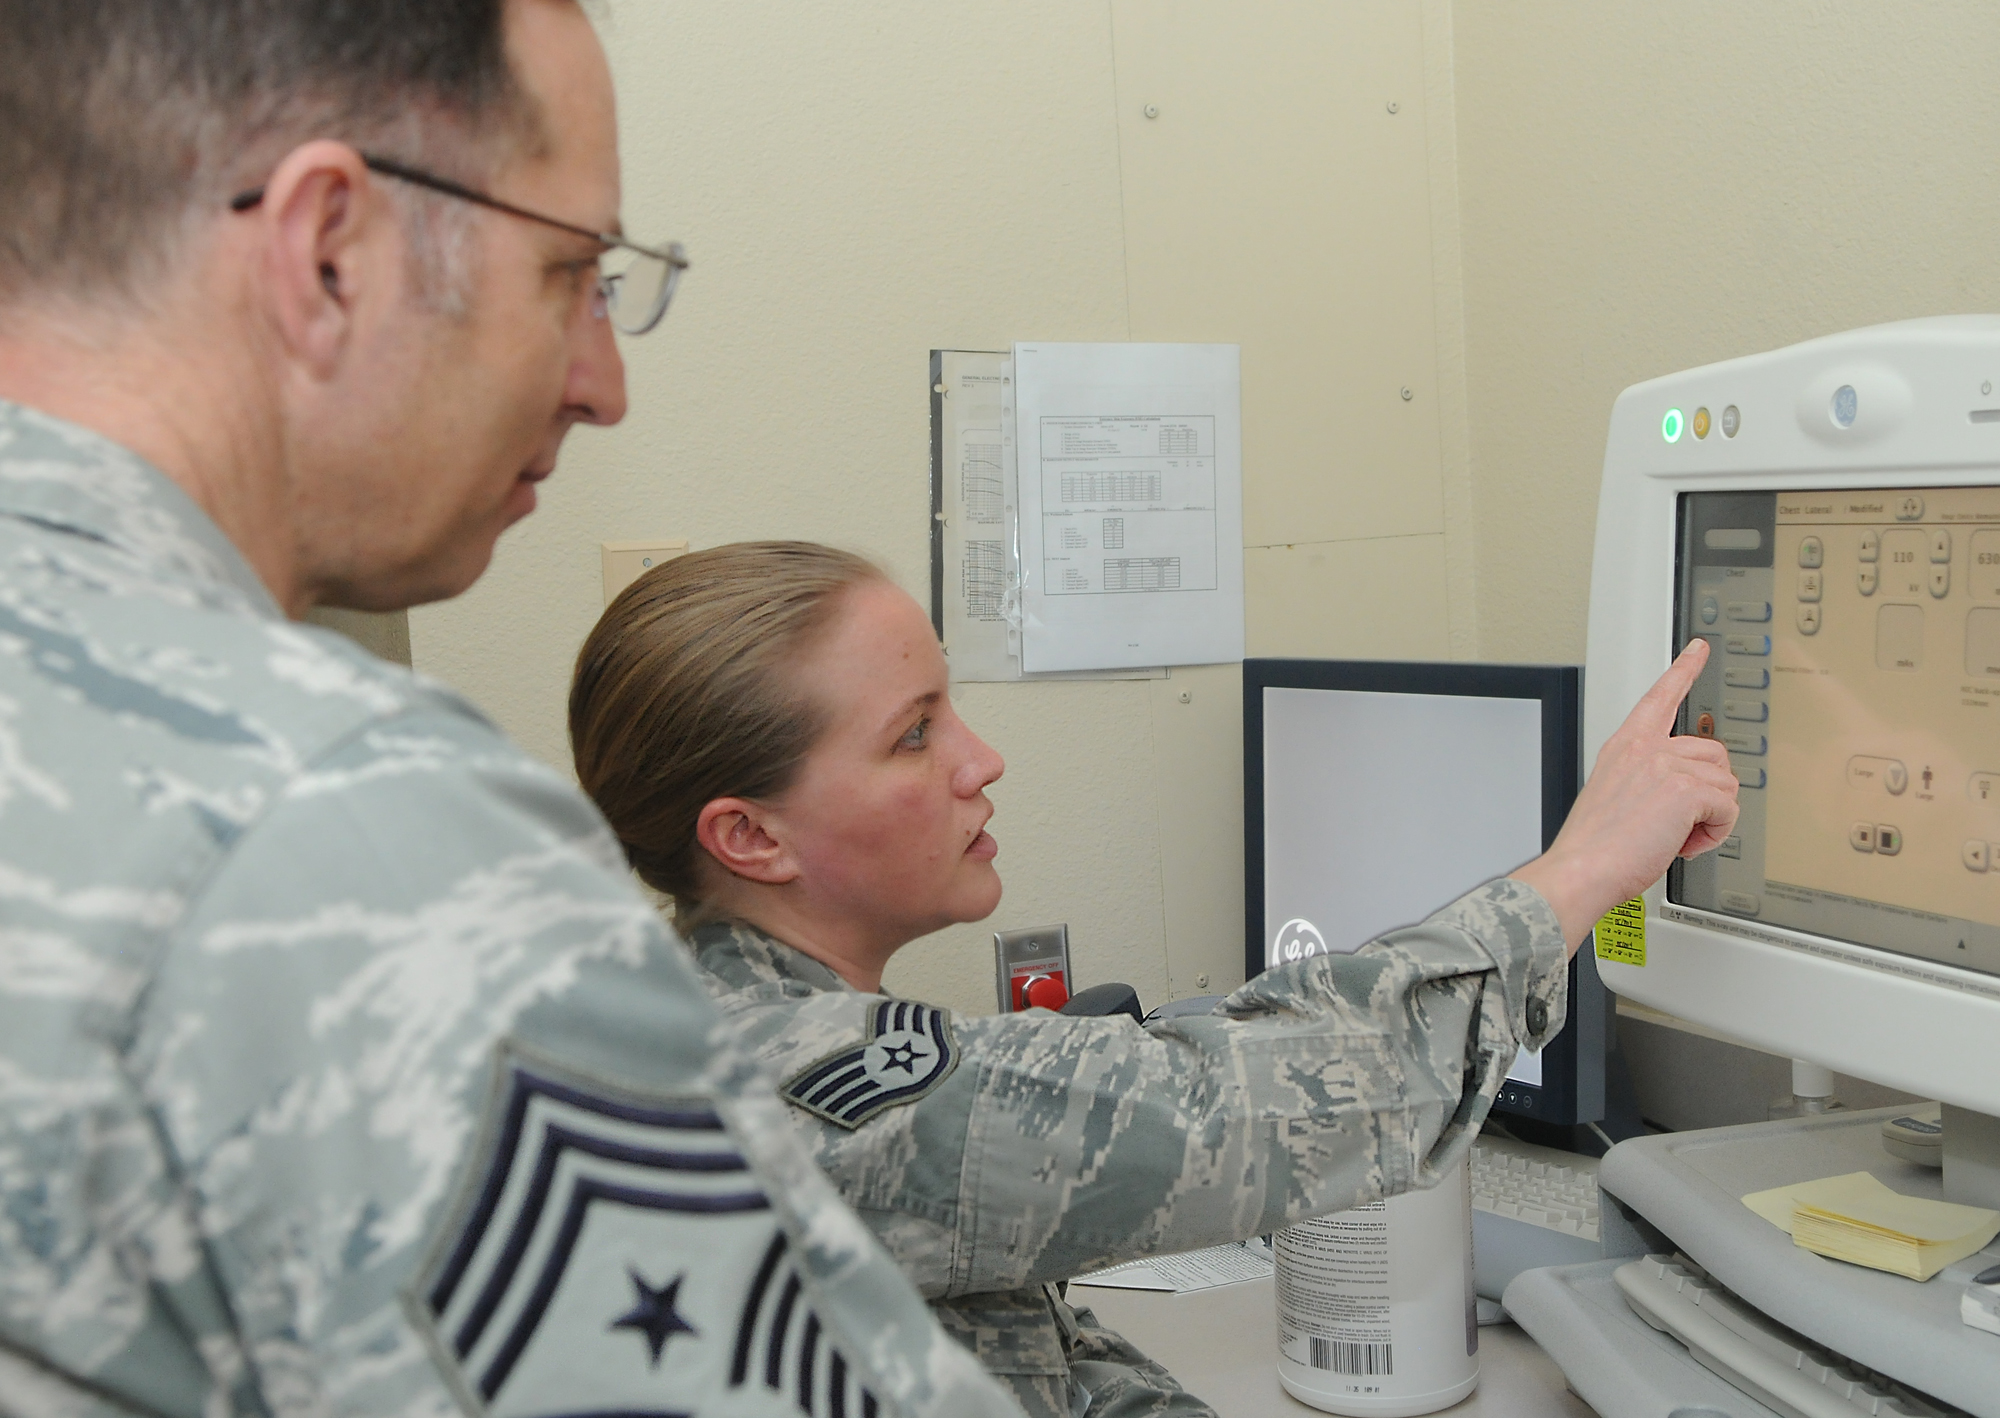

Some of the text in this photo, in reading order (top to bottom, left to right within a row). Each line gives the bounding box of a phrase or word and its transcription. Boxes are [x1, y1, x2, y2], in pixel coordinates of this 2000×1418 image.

[1805, 504, 1832, 514] Lateral
[1850, 504, 1883, 514] Modified
[1893, 552, 1914, 563] 110
[1977, 552, 2000, 565] 630
[1706, 918, 1716, 928] This
[1716, 922, 1730, 932] x-ray
[1730, 924, 1739, 933] unit
[1739, 928, 1750, 937] may
[1750, 930, 1758, 938] be
[1758, 931, 1784, 944] dangerous
[1790, 940, 1809, 951] patient
[1810, 944, 1820, 953] and
[1820, 948, 1844, 960] operator
[1844, 952, 1862, 964] unless
[1862, 957, 1874, 967] safe
[1875, 961, 1901, 974] exposure
[1902, 966, 1922, 978] factors
[1922, 971, 1934, 980] and
[1935, 975, 1964, 990] operating
[1014, 964, 1046, 973] EMERGENCY
